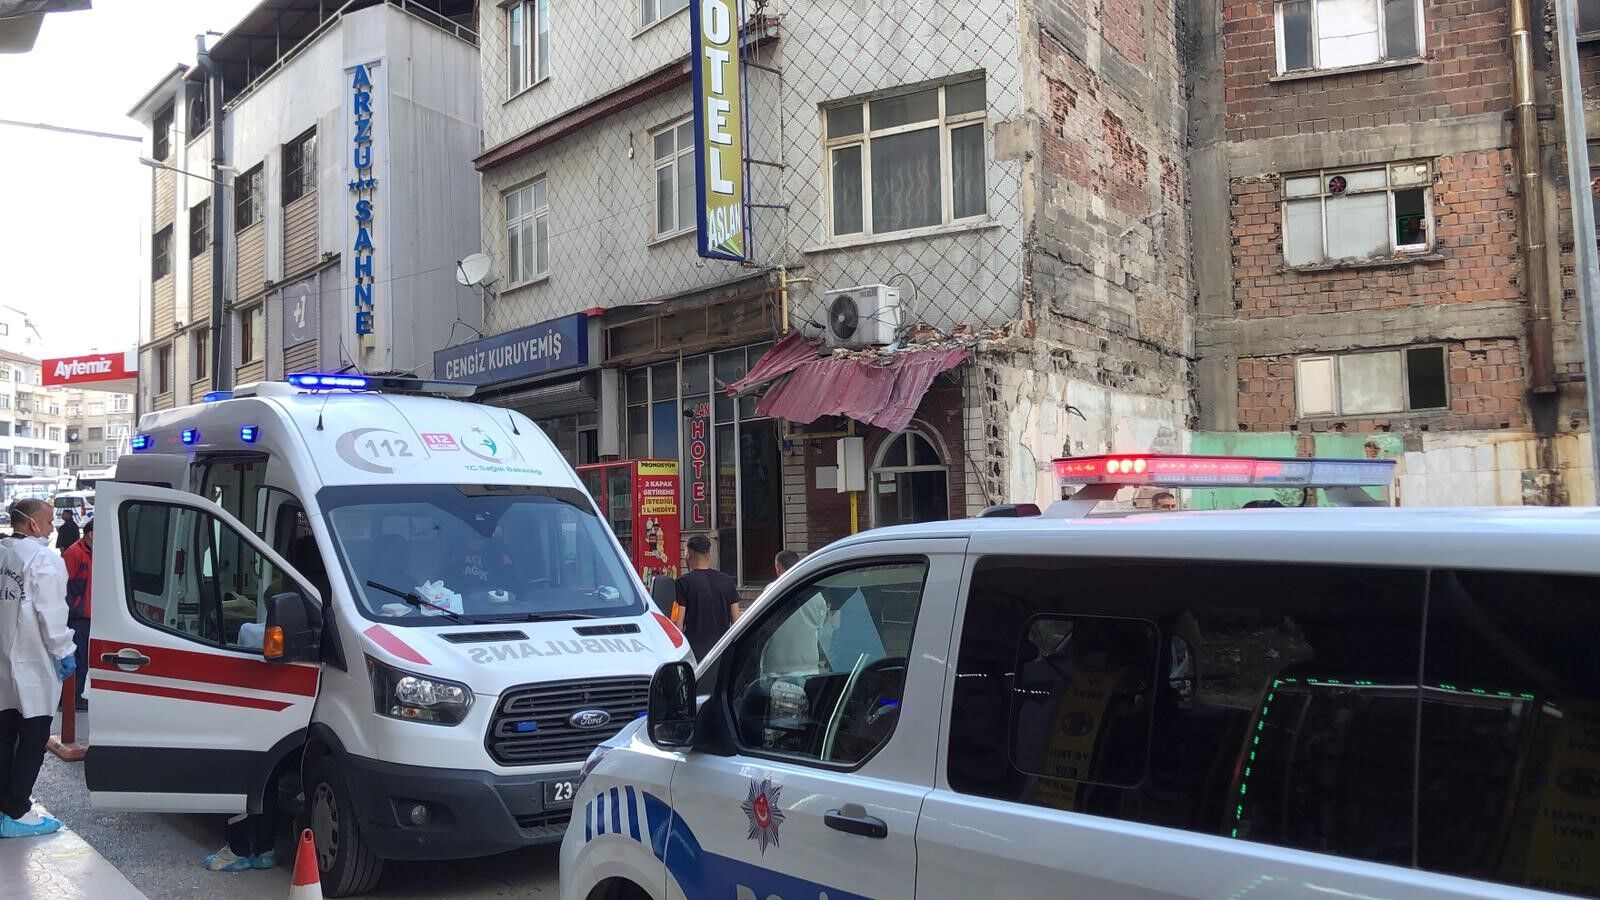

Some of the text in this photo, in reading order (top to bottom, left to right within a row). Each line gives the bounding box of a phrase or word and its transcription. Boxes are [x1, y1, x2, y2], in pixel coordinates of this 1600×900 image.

[352, 64, 375, 335] ARZU SAHNE
[708, 202, 741, 251] ASLAN
[445, 329, 562, 380] CENGİZ KURUYEMİŞ
[53, 357, 113, 380] Aytemiz
[364, 439, 414, 458] 112
[426, 434, 452, 444] 112
[691, 419, 706, 523] HOTEL
[643, 487, 675, 496] GETİRENE
[645, 496, 673, 505] İSTEDİĞİ
[652, 504, 675, 513] HEDİYE
[580, 713, 602, 726] Ford
[554, 781, 573, 801] 23
